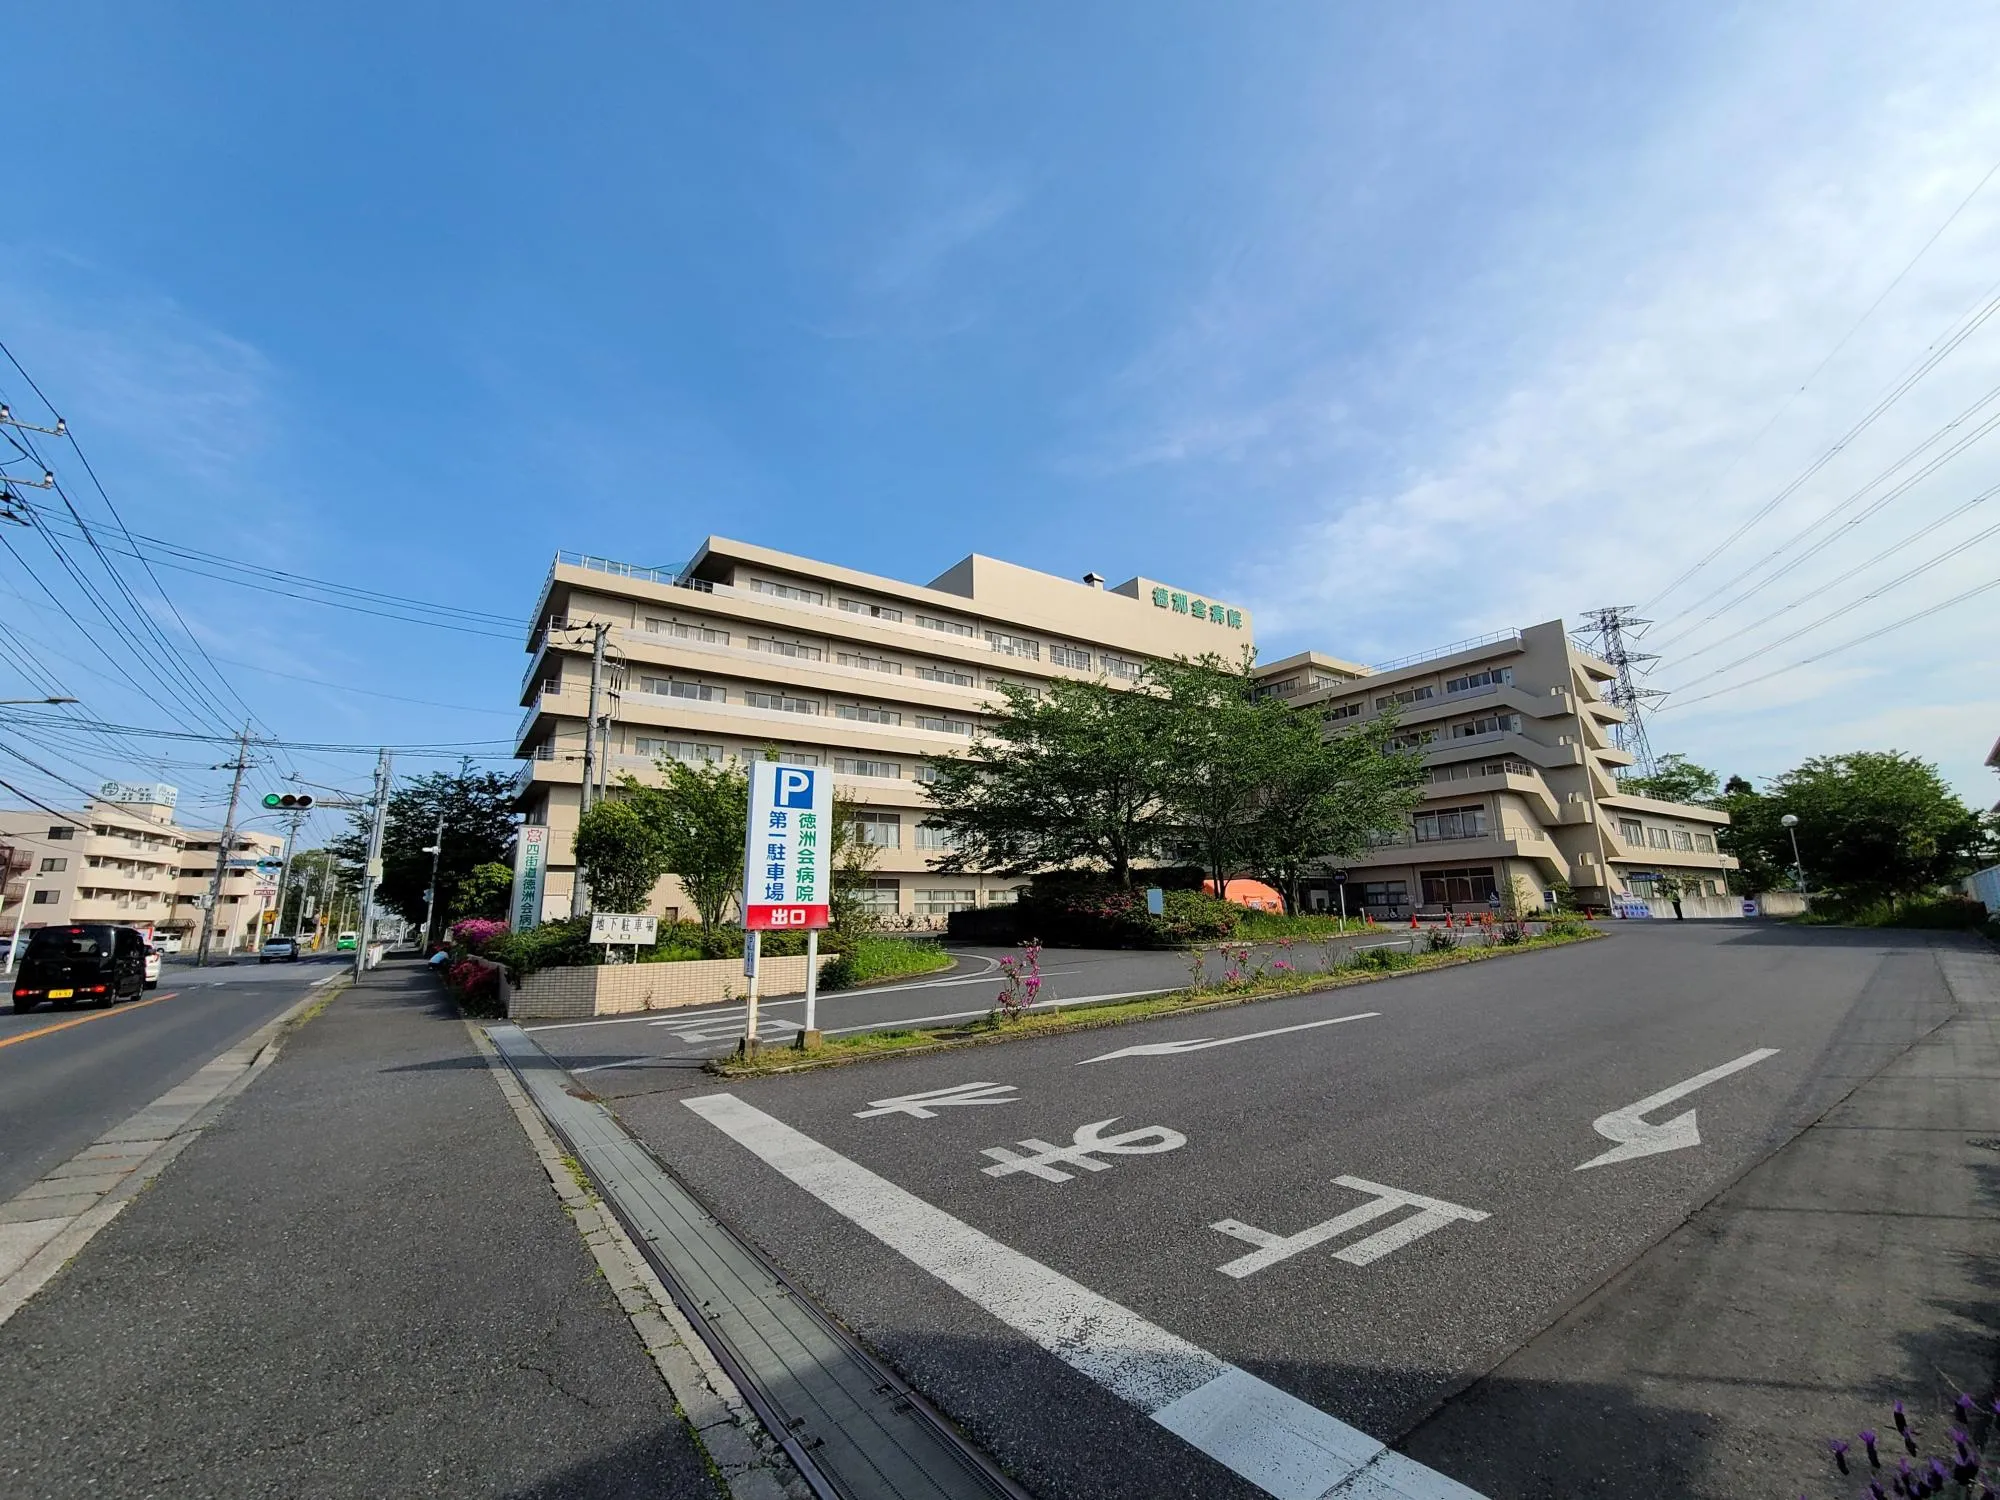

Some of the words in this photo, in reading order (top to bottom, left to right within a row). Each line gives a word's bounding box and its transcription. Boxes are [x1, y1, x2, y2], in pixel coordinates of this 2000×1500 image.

[780, 770, 809, 806] P
[765, 810, 787, 901] 第一駐車場
[796, 813, 816, 902] 徳洲会病院
[595, 917, 654, 932] 地下駐車場
[771, 909, 806, 925] 出口
